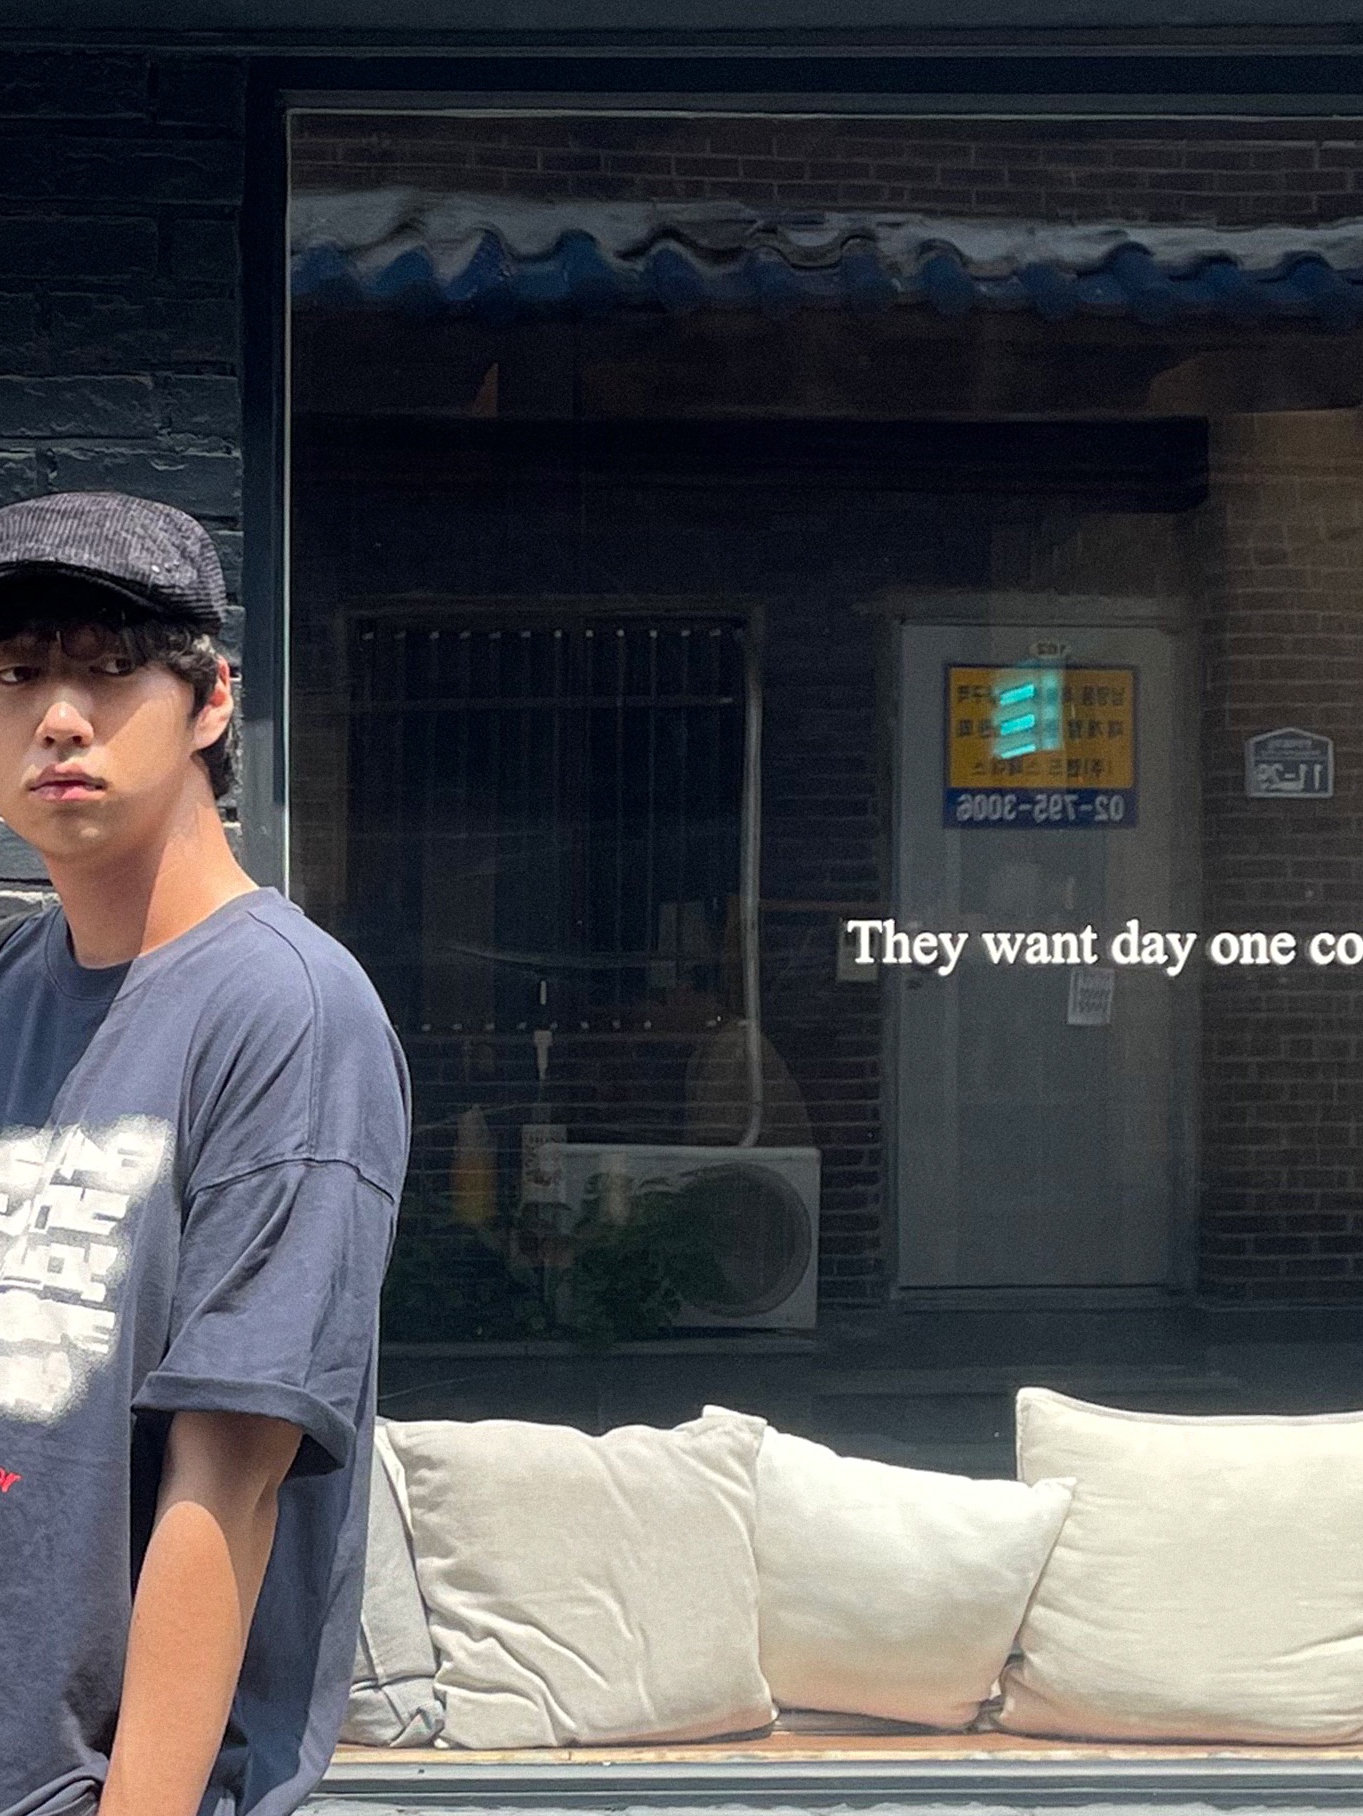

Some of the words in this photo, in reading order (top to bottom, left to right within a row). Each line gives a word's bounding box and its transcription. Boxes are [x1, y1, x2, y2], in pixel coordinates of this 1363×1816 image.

[847, 919, 968, 976] They
[981, 923, 1098, 965] want
[1112, 919, 1197, 976] day
[1210, 931, 1296, 965] one
[1309, 931, 1363, 965] co
